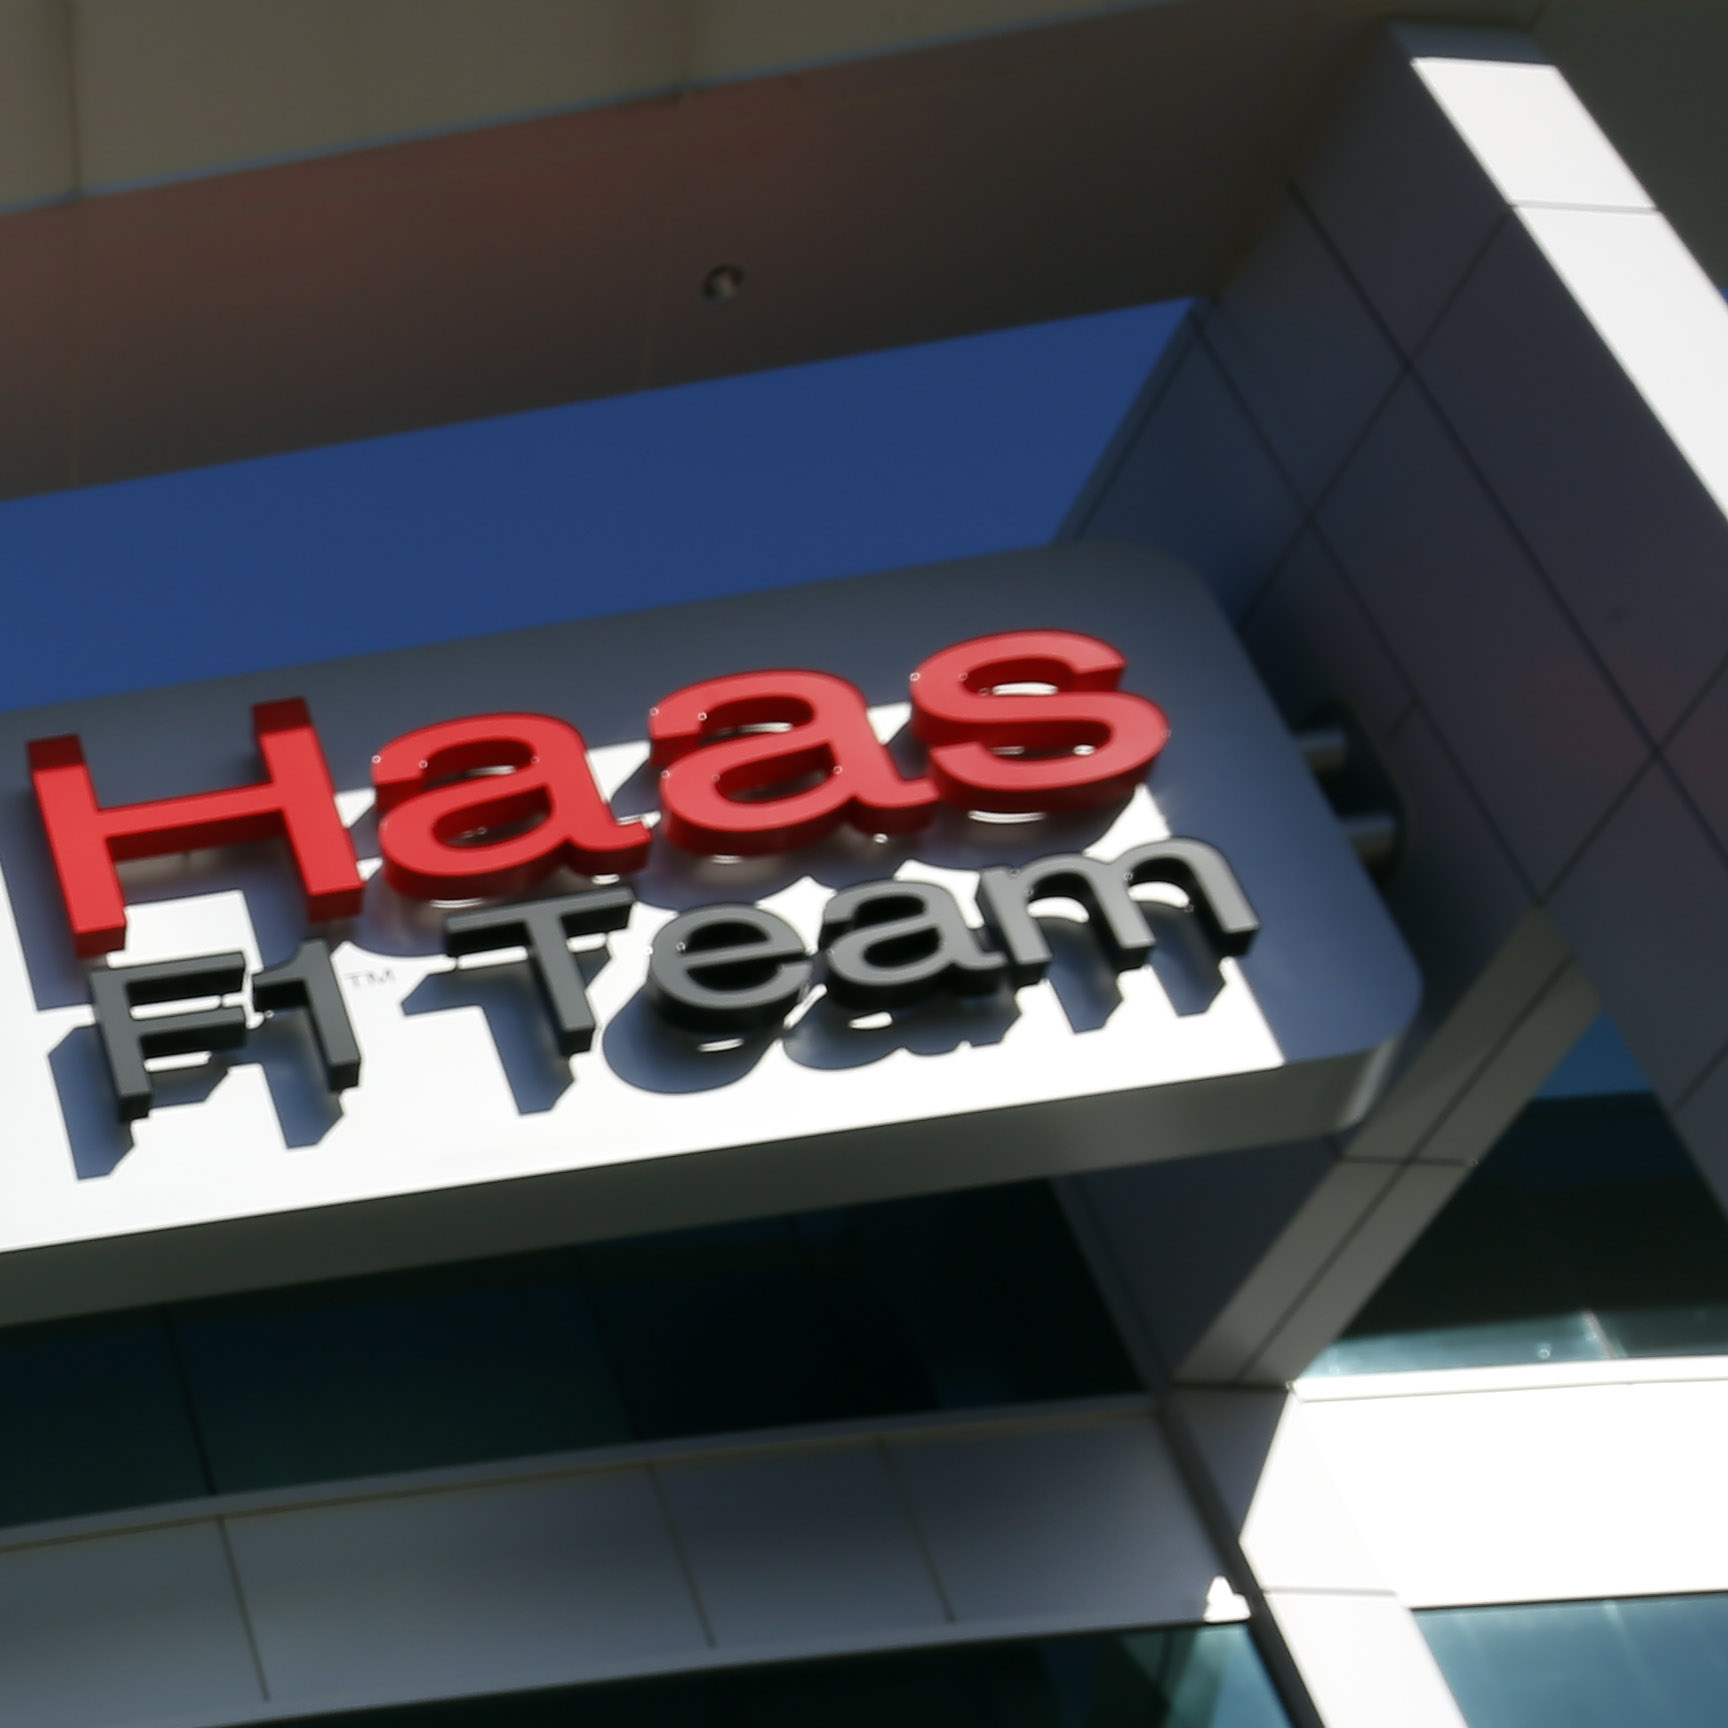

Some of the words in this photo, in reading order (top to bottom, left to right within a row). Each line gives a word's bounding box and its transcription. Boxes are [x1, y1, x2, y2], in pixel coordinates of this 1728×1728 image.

[27, 628, 1171, 958] Haas
[90, 939, 361, 1124] F1
[445, 836, 1261, 1058] Team
